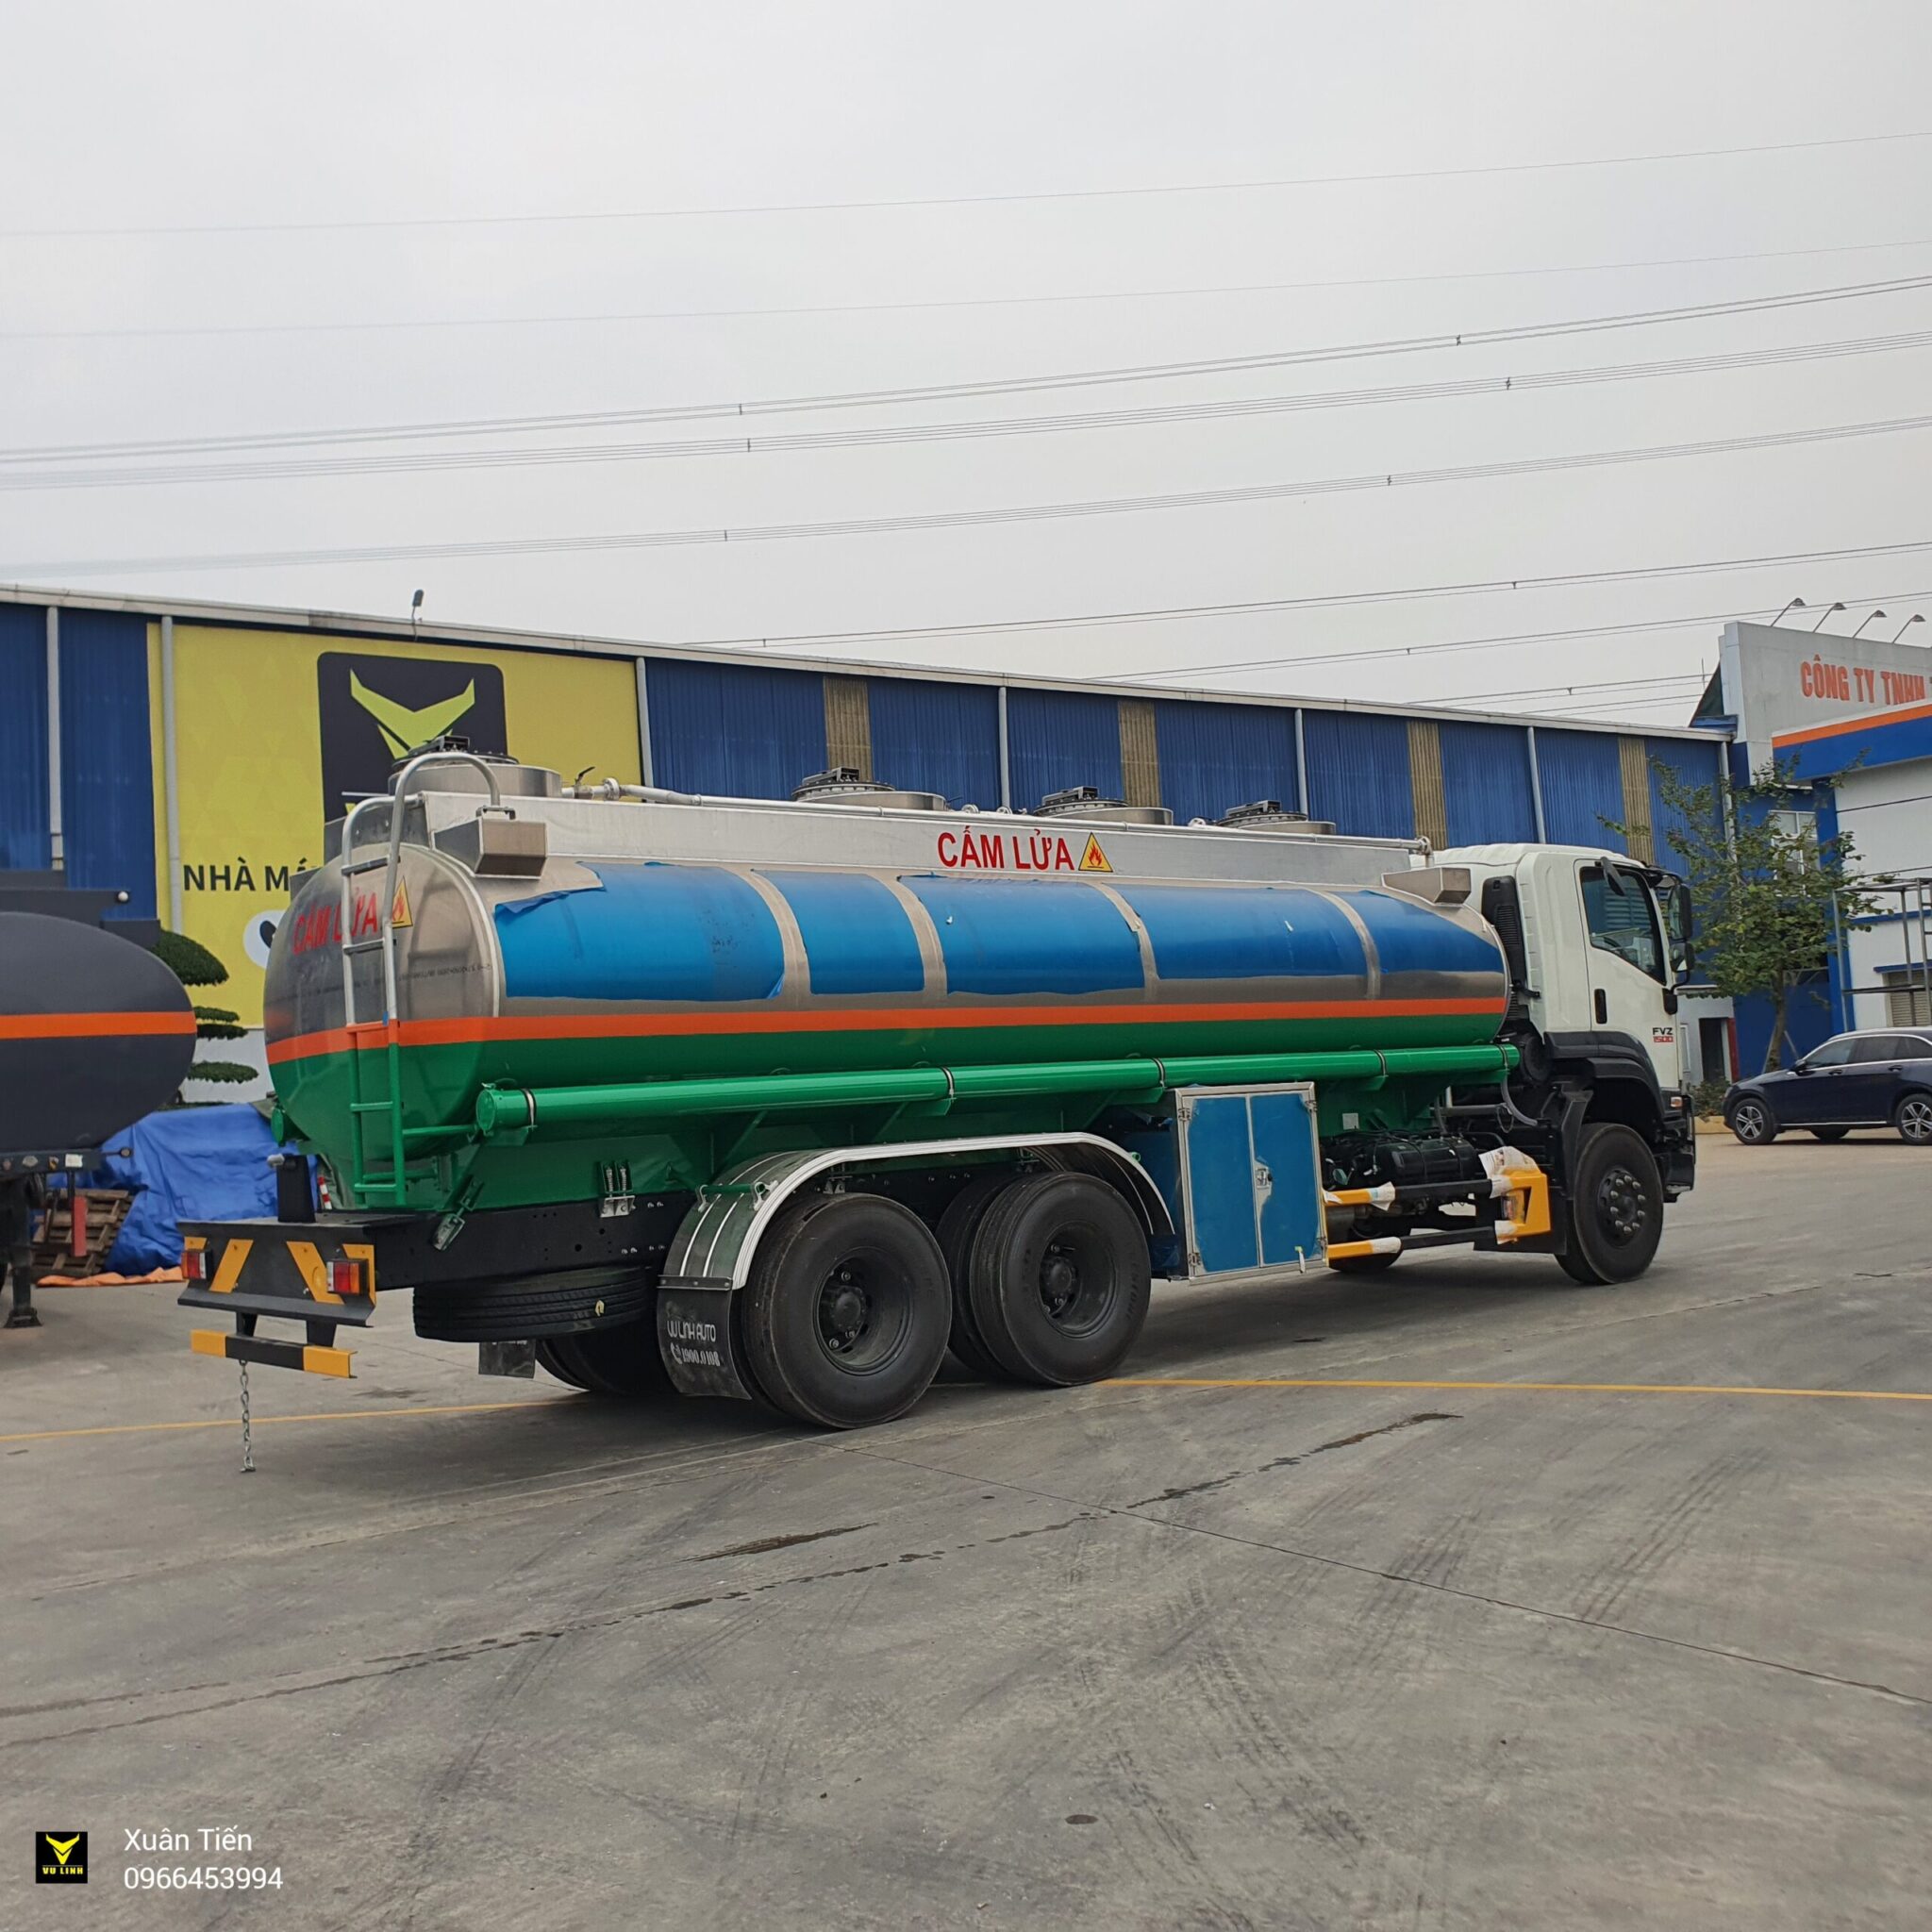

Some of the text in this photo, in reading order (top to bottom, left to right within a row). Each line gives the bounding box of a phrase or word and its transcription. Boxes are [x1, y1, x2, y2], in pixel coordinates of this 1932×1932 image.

[1800, 654, 1925, 705] CÔNG TY TNHH
[937, 825, 1074, 871] CẤM LỬA
[183, 856, 256, 891] NHÀ
[696, 1323, 717, 1342] AUTO
